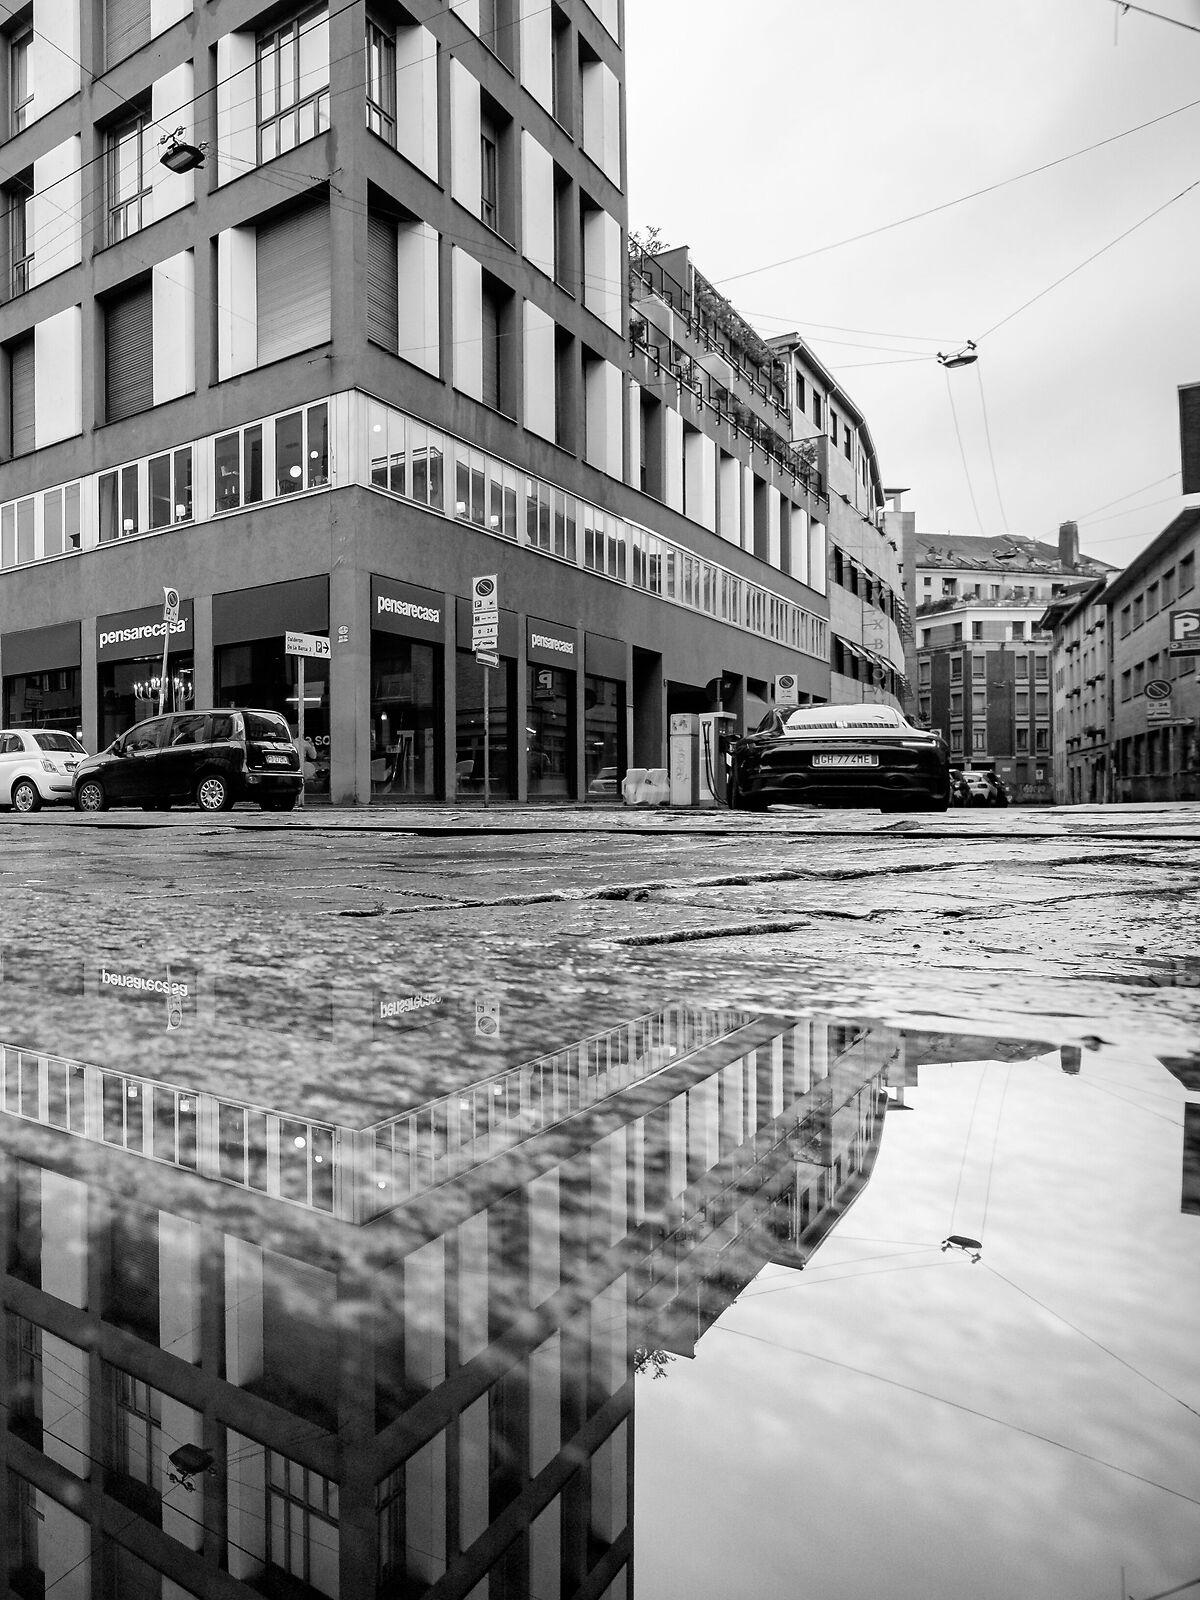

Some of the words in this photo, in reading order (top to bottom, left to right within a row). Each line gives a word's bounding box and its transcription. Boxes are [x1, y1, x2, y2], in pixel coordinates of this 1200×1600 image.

[377, 596, 440, 623] pensarecasa
[99, 619, 186, 648] pensarecasa
[531, 633, 574, 654] pensarecasa
